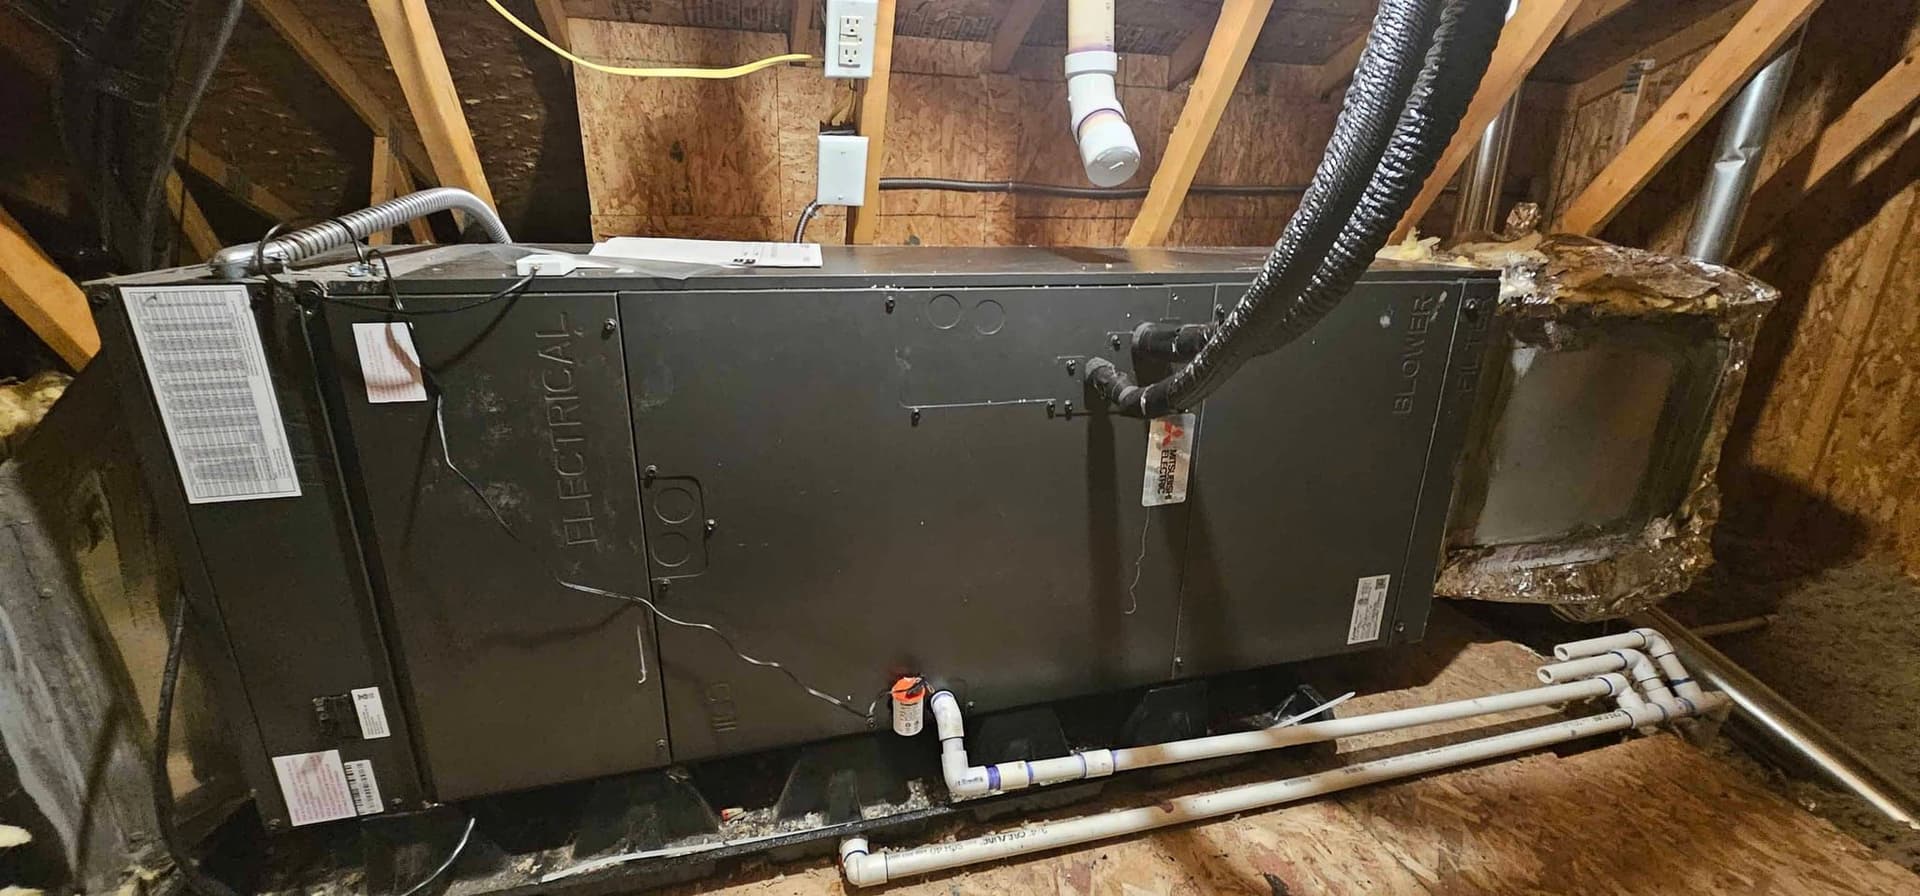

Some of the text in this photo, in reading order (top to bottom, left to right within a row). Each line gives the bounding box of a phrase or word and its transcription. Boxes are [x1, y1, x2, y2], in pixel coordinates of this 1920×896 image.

[1392, 297, 1434, 414] BLOWER
[536, 312, 600, 547] ELECTRICAL
[1157, 449, 1170, 494] ELECTRIC
[1165, 449, 1177, 499] MITSUBISHI
